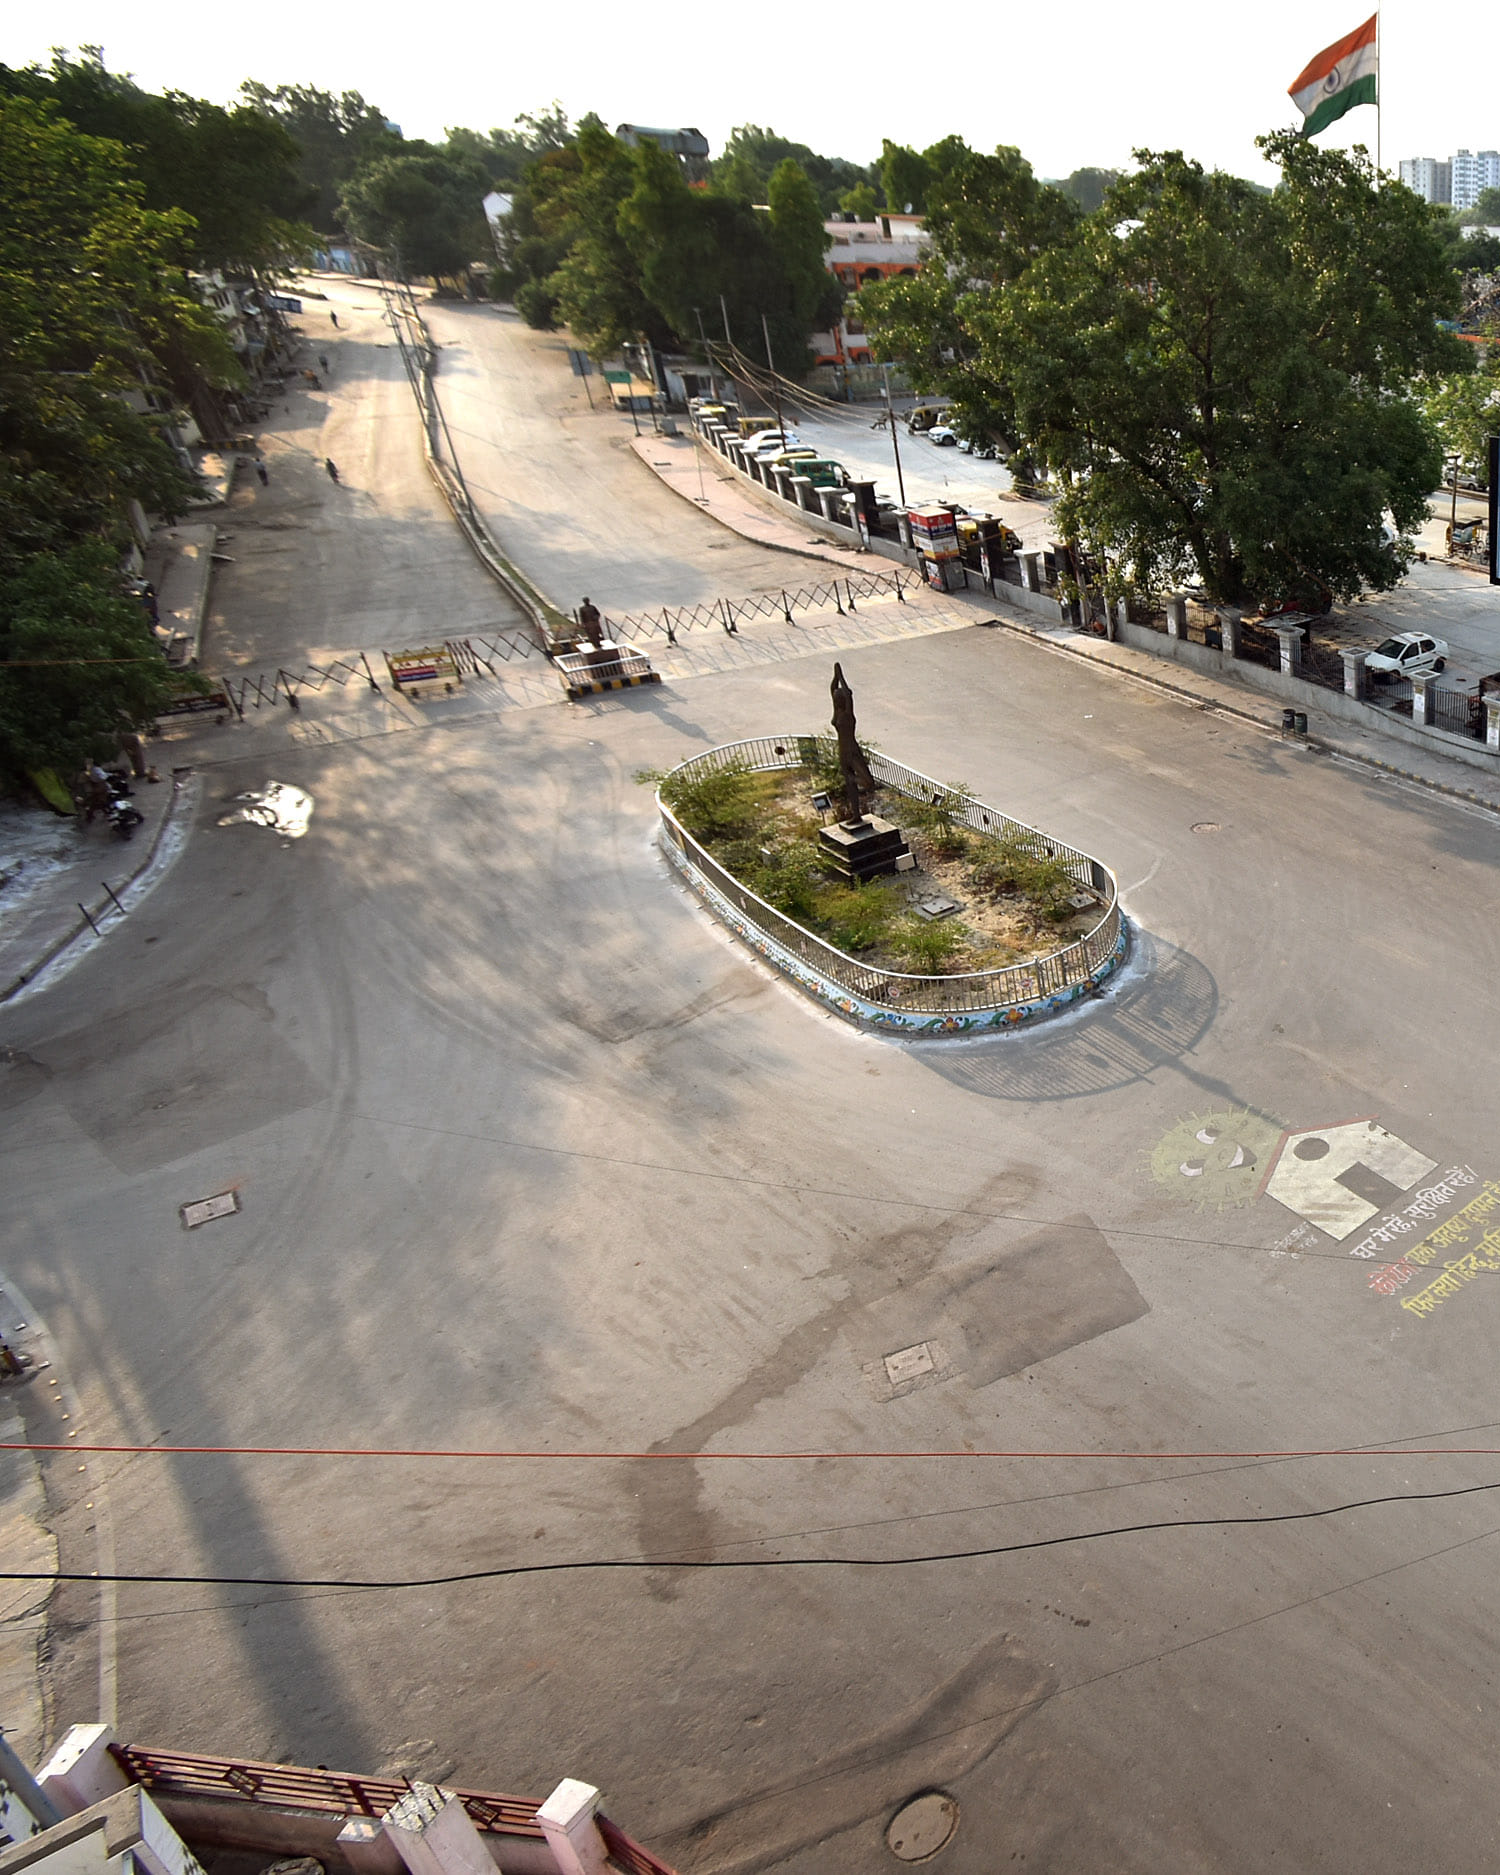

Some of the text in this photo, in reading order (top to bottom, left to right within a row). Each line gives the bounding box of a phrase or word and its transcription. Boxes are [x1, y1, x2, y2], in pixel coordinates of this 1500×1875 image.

[1349, 1236, 1384, 1259] घर
[1401, 1187, 1457, 1220] सुरक्षित
[1403, 1240, 1438, 1265] एक
[1400, 1289, 1443, 1319] फिर
[1427, 1271, 1463, 1298] क्या
